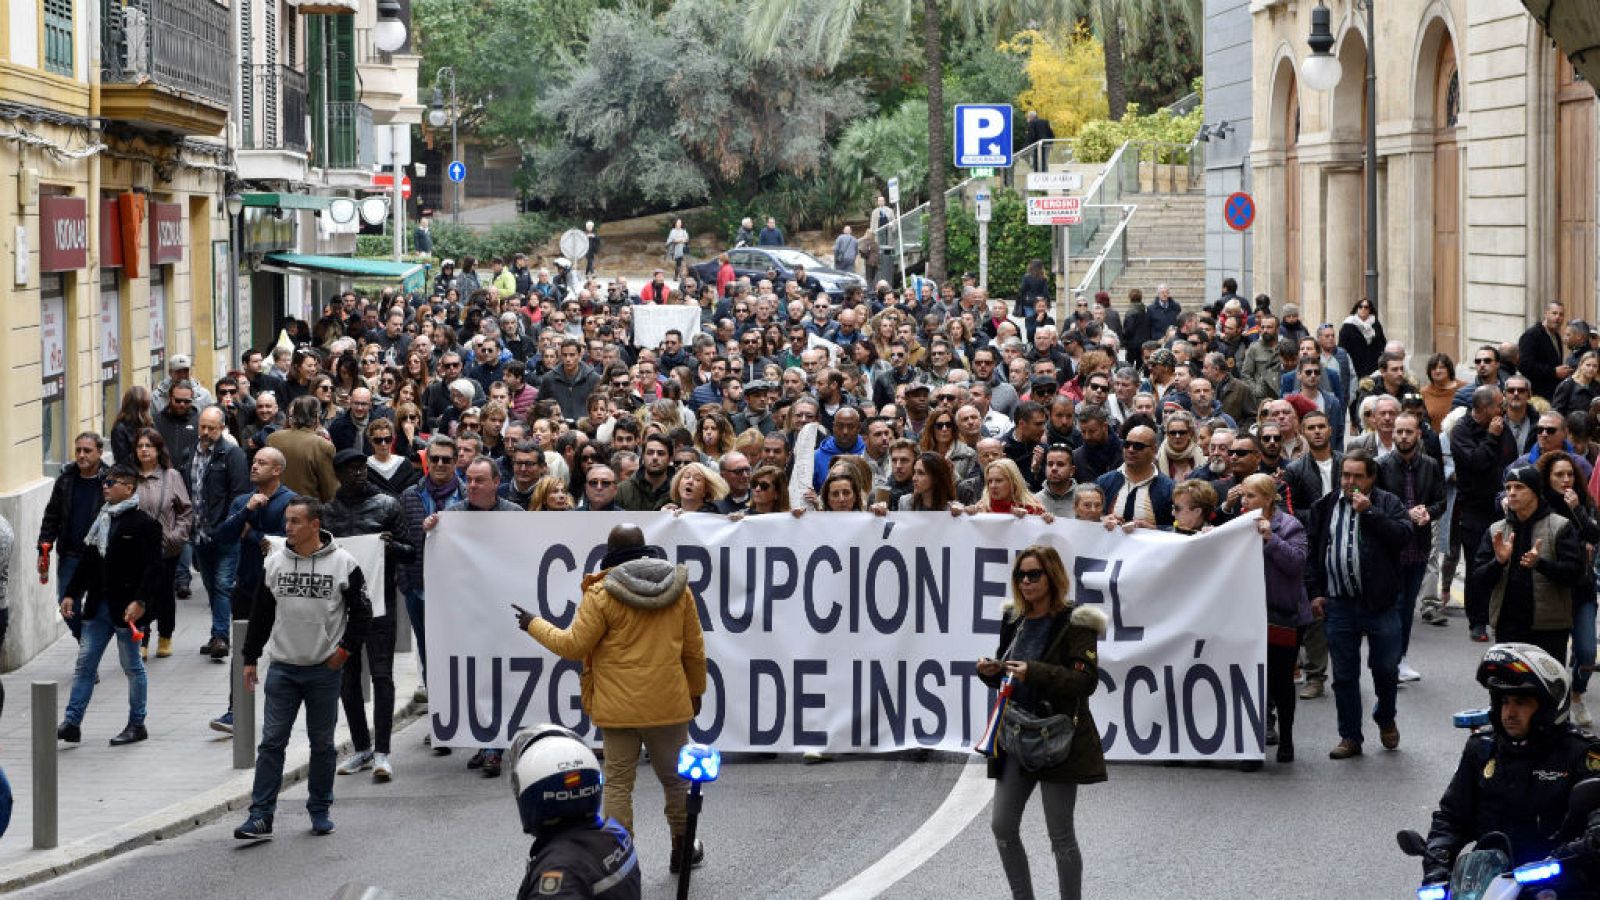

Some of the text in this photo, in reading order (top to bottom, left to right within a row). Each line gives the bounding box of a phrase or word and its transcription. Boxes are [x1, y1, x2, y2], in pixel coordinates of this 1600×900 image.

[963, 107, 1004, 155] P
[1043, 198, 1076, 209] EROSKI
[276, 587, 332, 600] BOXING
[277, 572, 334, 589] HONOR
[538, 521, 951, 634] CRUPCIÓN
[1075, 555, 1145, 642] EL
[432, 639, 1265, 755] JUZGO DE INSTCCIÓN
